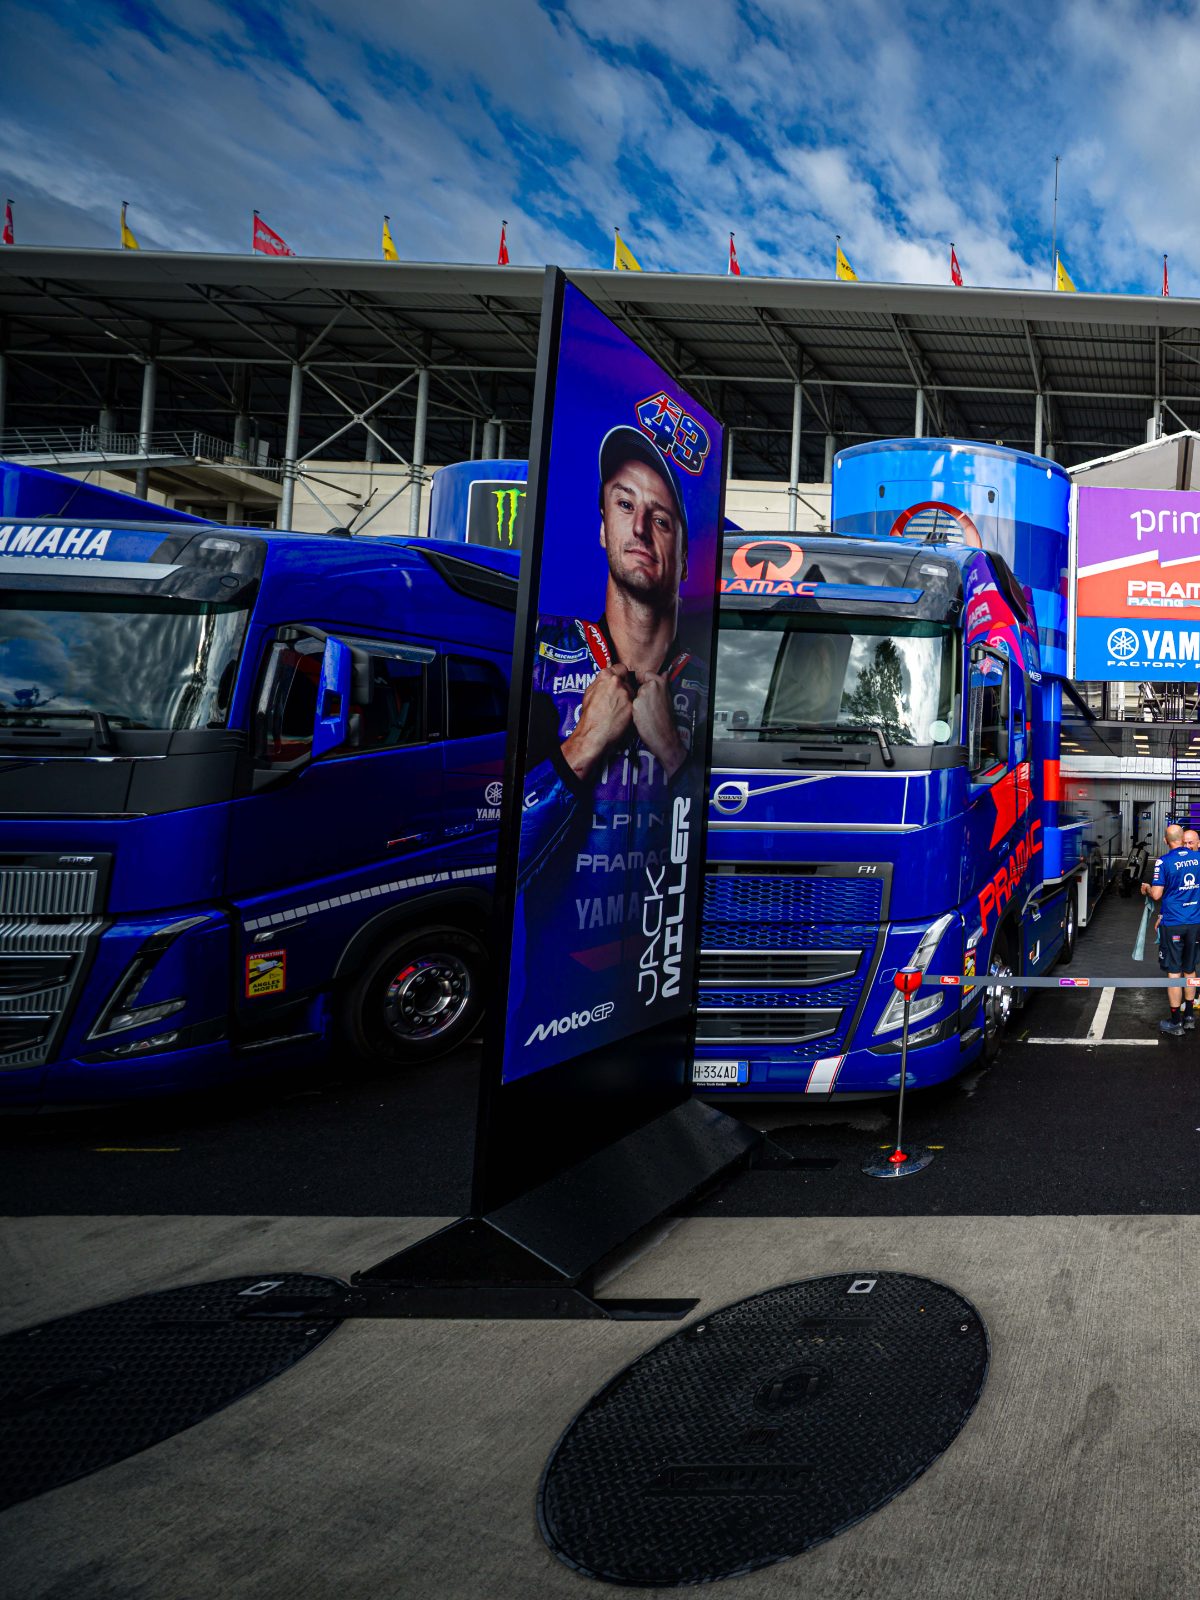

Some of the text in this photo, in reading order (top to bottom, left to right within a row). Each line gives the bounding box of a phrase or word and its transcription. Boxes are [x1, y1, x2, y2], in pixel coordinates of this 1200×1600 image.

[635, 391, 709, 476] 43
[0, 525, 112, 555] AMAHA
[1127, 597, 1185, 608] RACING
[1106, 660, 1187, 670] FACTORY
[476, 808, 501, 819] YAMA
[858, 865, 877, 874] FH
[978, 818, 1043, 937] PRAMAC
[575, 891, 641, 930] YAMA
[661, 796, 691, 998] MILLER
[638, 865, 666, 1006] JACK
